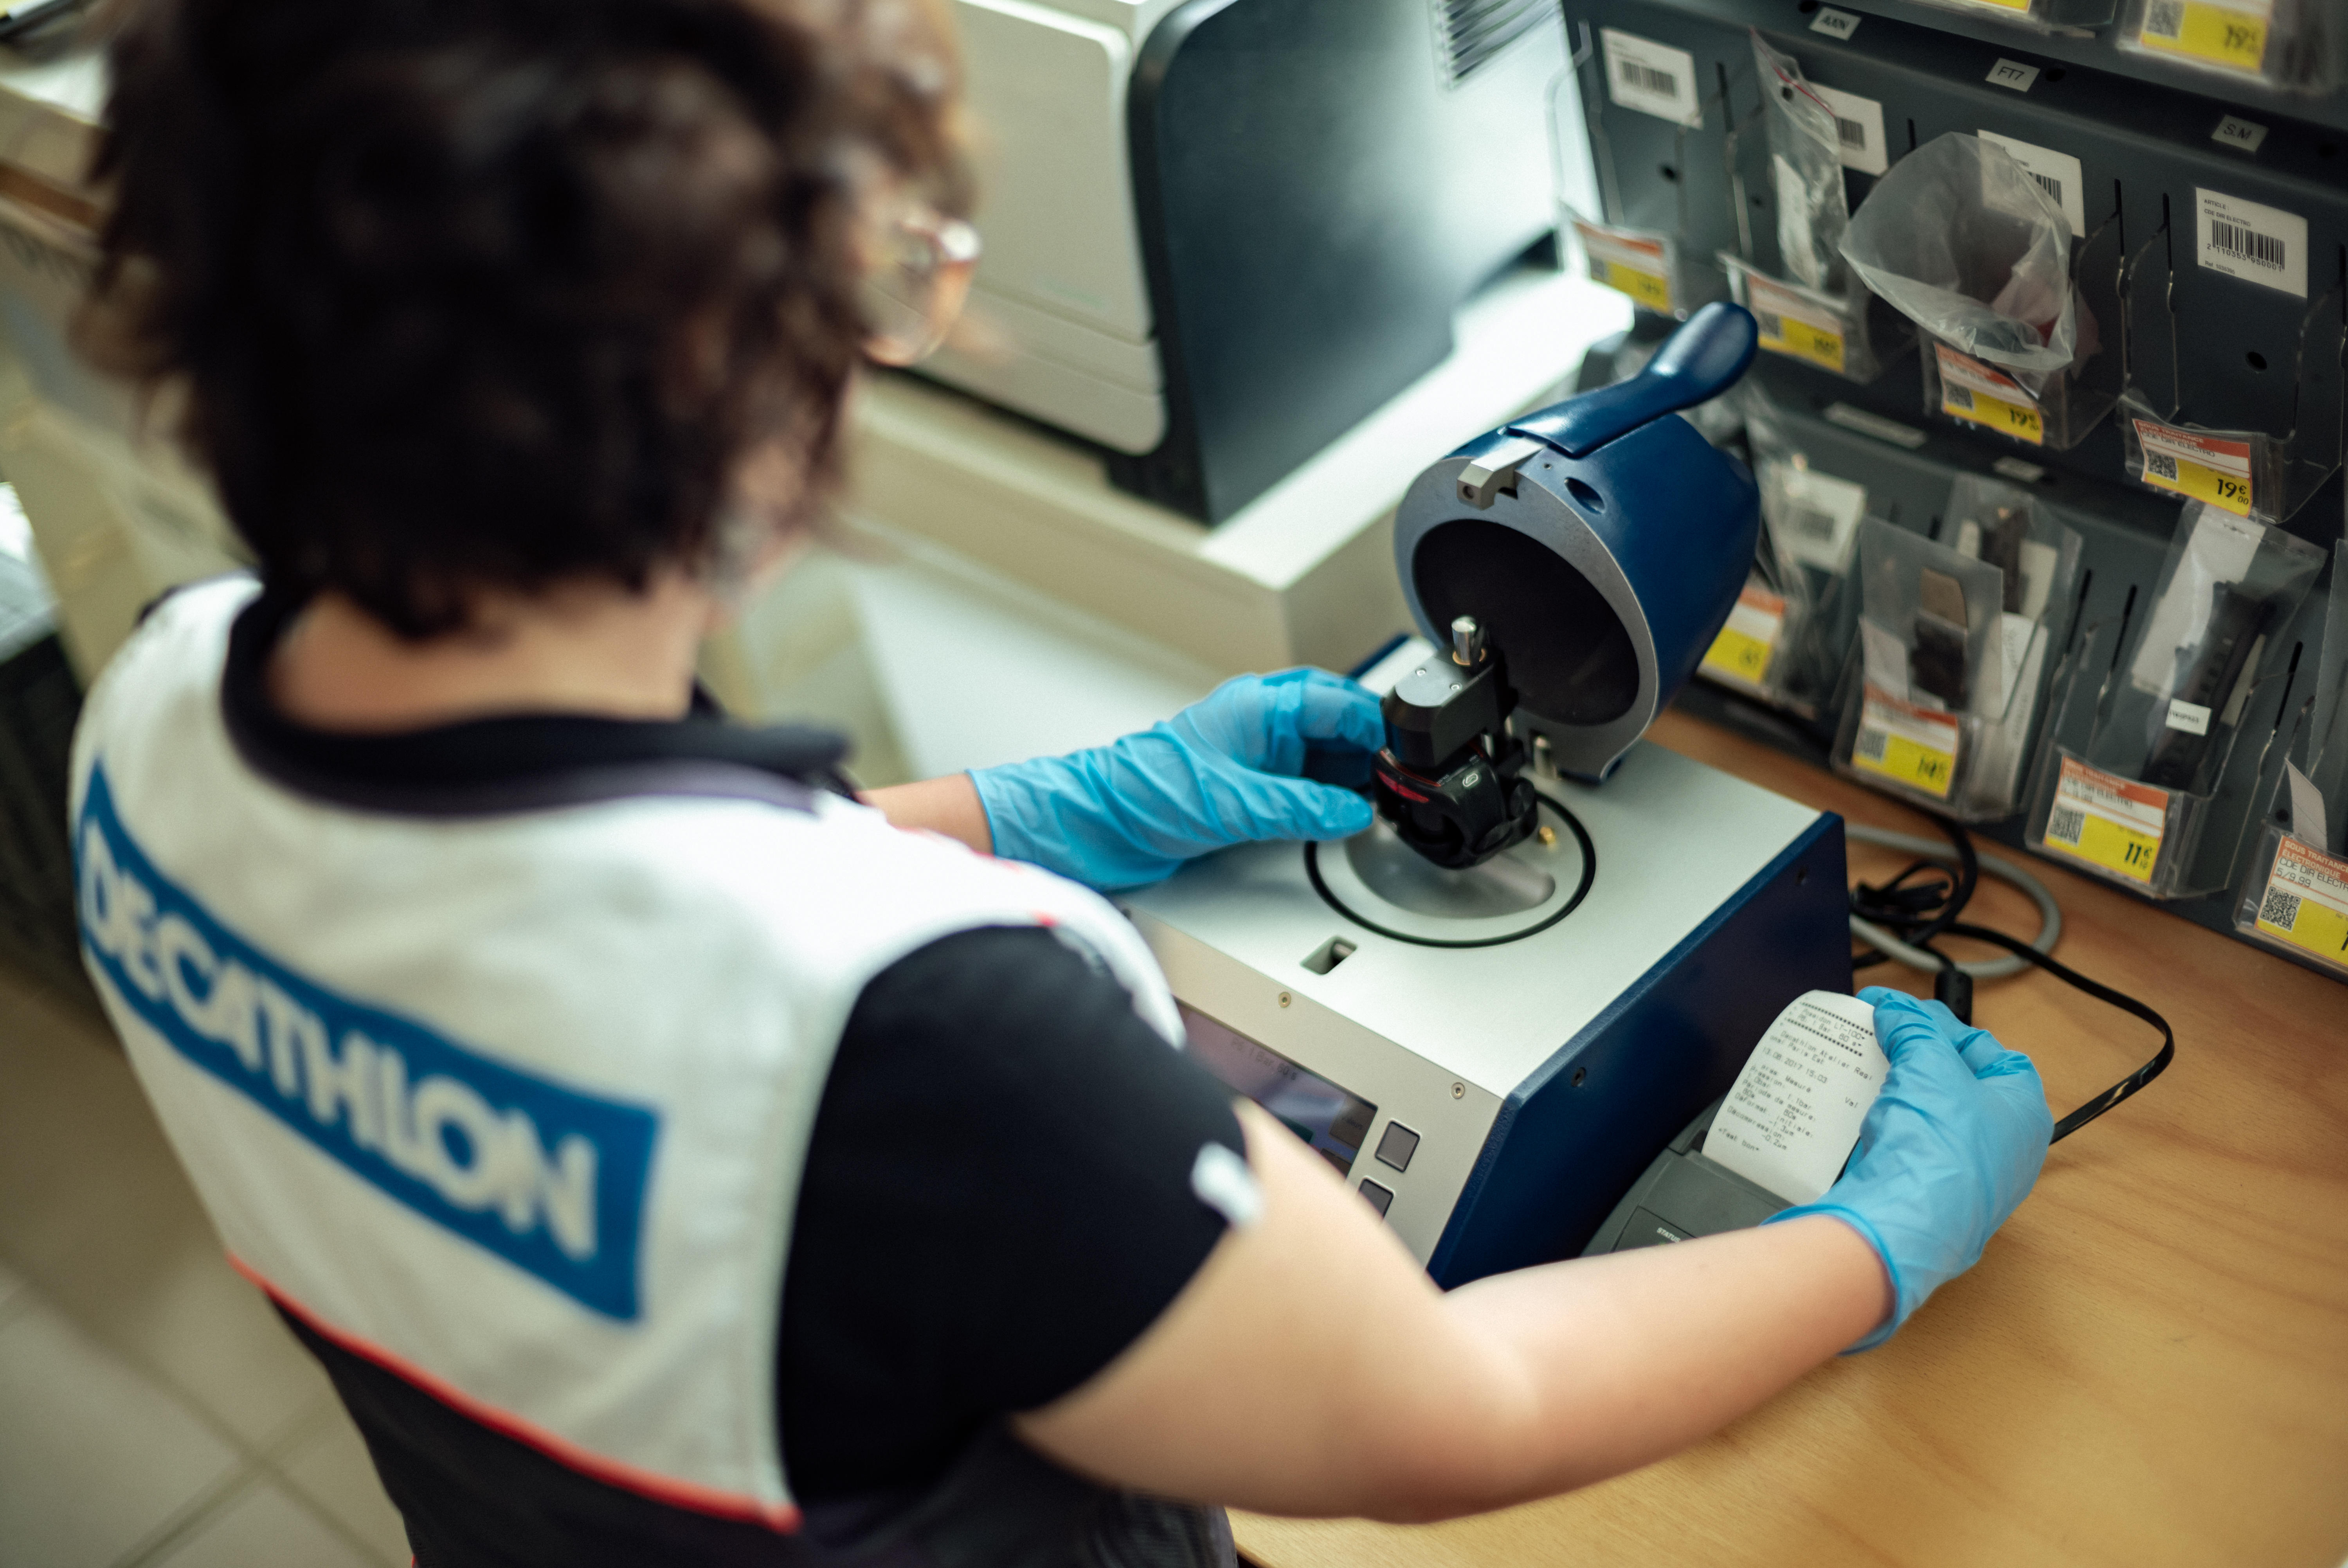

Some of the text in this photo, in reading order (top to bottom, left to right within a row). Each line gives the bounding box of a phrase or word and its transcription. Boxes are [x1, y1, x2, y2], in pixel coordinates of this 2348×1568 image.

[1997, 66, 2025, 82] FT7
[2226, 215, 2251, 227] ELECTRO
[2217, 246, 2247, 261] 110353
[2251, 257, 2282, 273] 950001
[2178, 441, 2215, 457] ELECTRO
[2284, 840, 2306, 855] SOUS
[2279, 857, 2298, 870] CDE
[2300, 865, 2315, 878] DIR
[2282, 849, 2341, 879] ÉLECTRONIQUE
[2276, 867, 2311, 888] 5/9.99
[82, 820, 599, 1262] DECATHLON
[1788, 1041, 1809, 1057] Paris
[1811, 1054, 1825, 1065] Est
[1820, 1050, 1849, 1068] Atelier
[1774, 1097, 1784, 1105] de
[1845, 1096, 1858, 1109] Val
[1656, 1227, 1681, 1243] STATUS
